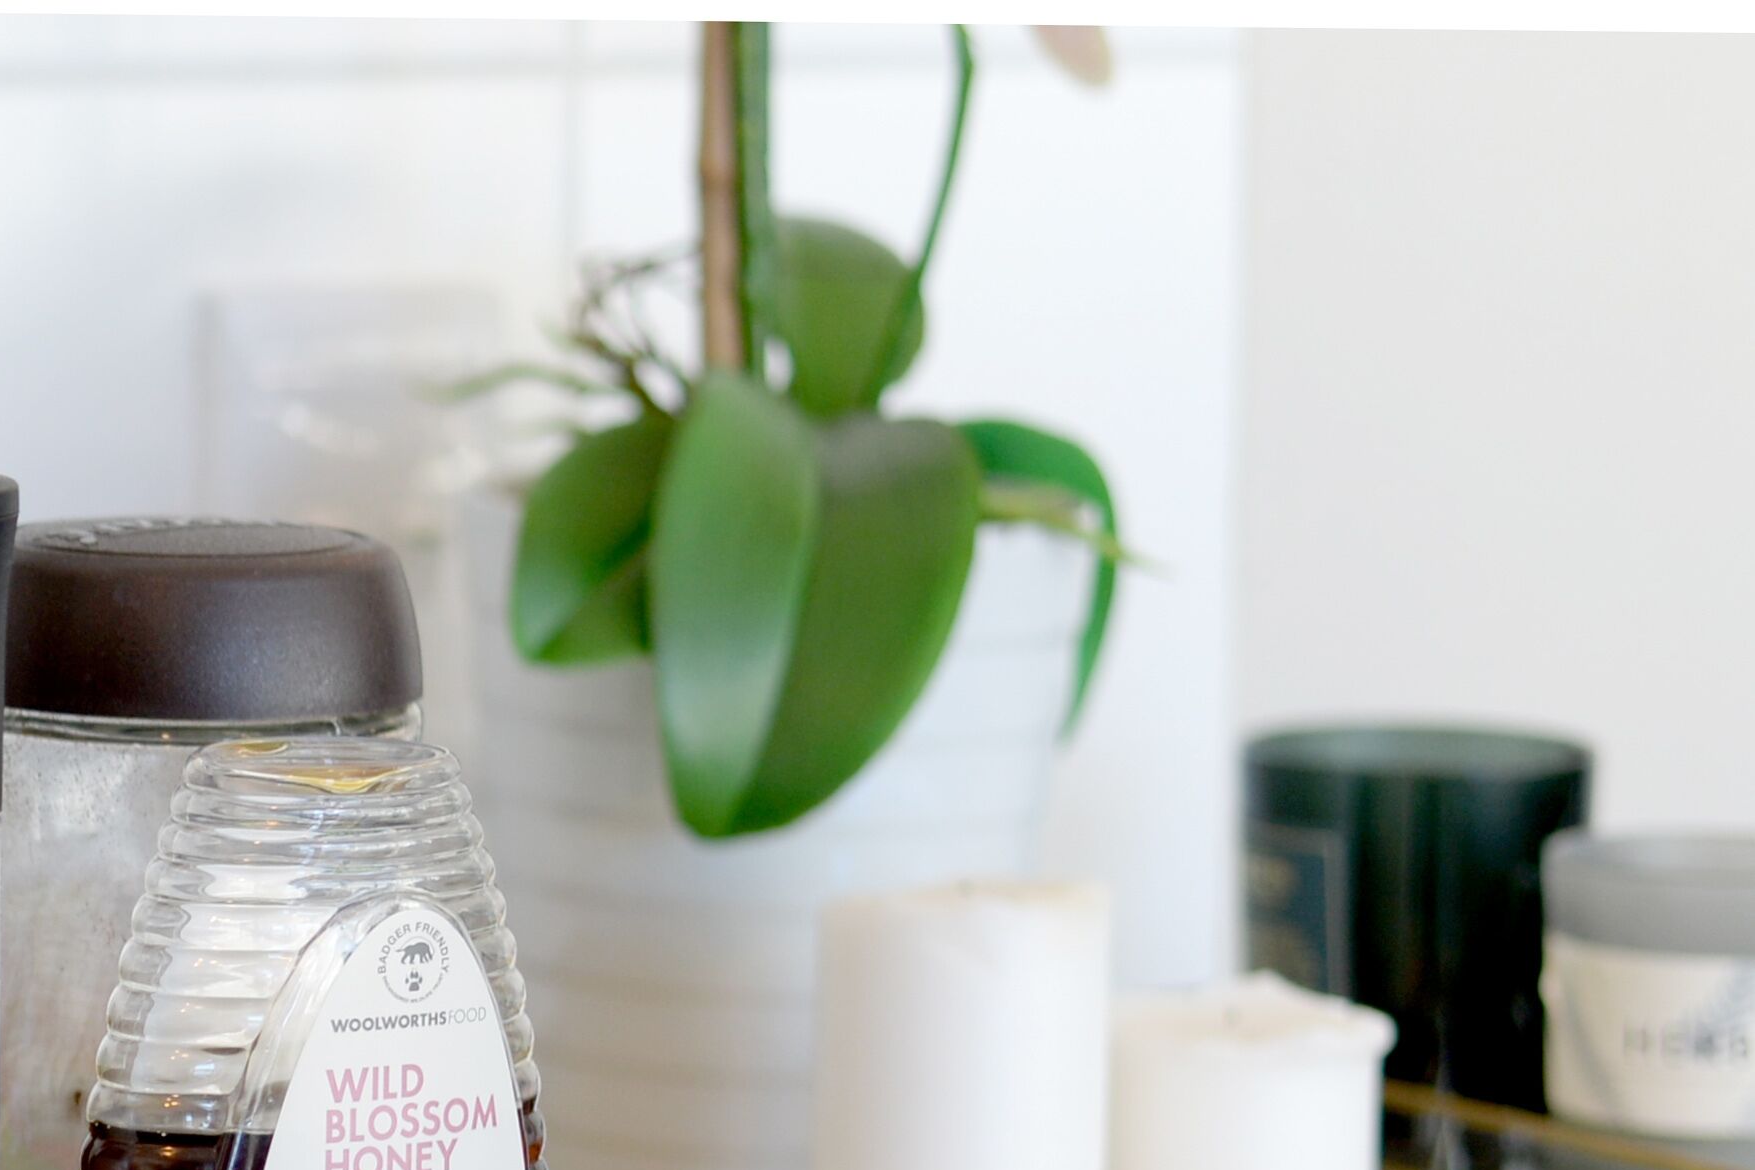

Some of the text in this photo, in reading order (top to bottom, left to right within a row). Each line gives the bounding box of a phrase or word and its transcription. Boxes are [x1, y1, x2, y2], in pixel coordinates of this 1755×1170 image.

[377, 921, 449, 974] BADGER FRIENDLY
[331, 1006, 487, 1033] WOOLWORTHSFOOD
[326, 1064, 424, 1103] WILD
[326, 1094, 497, 1143] BLOSSOM
